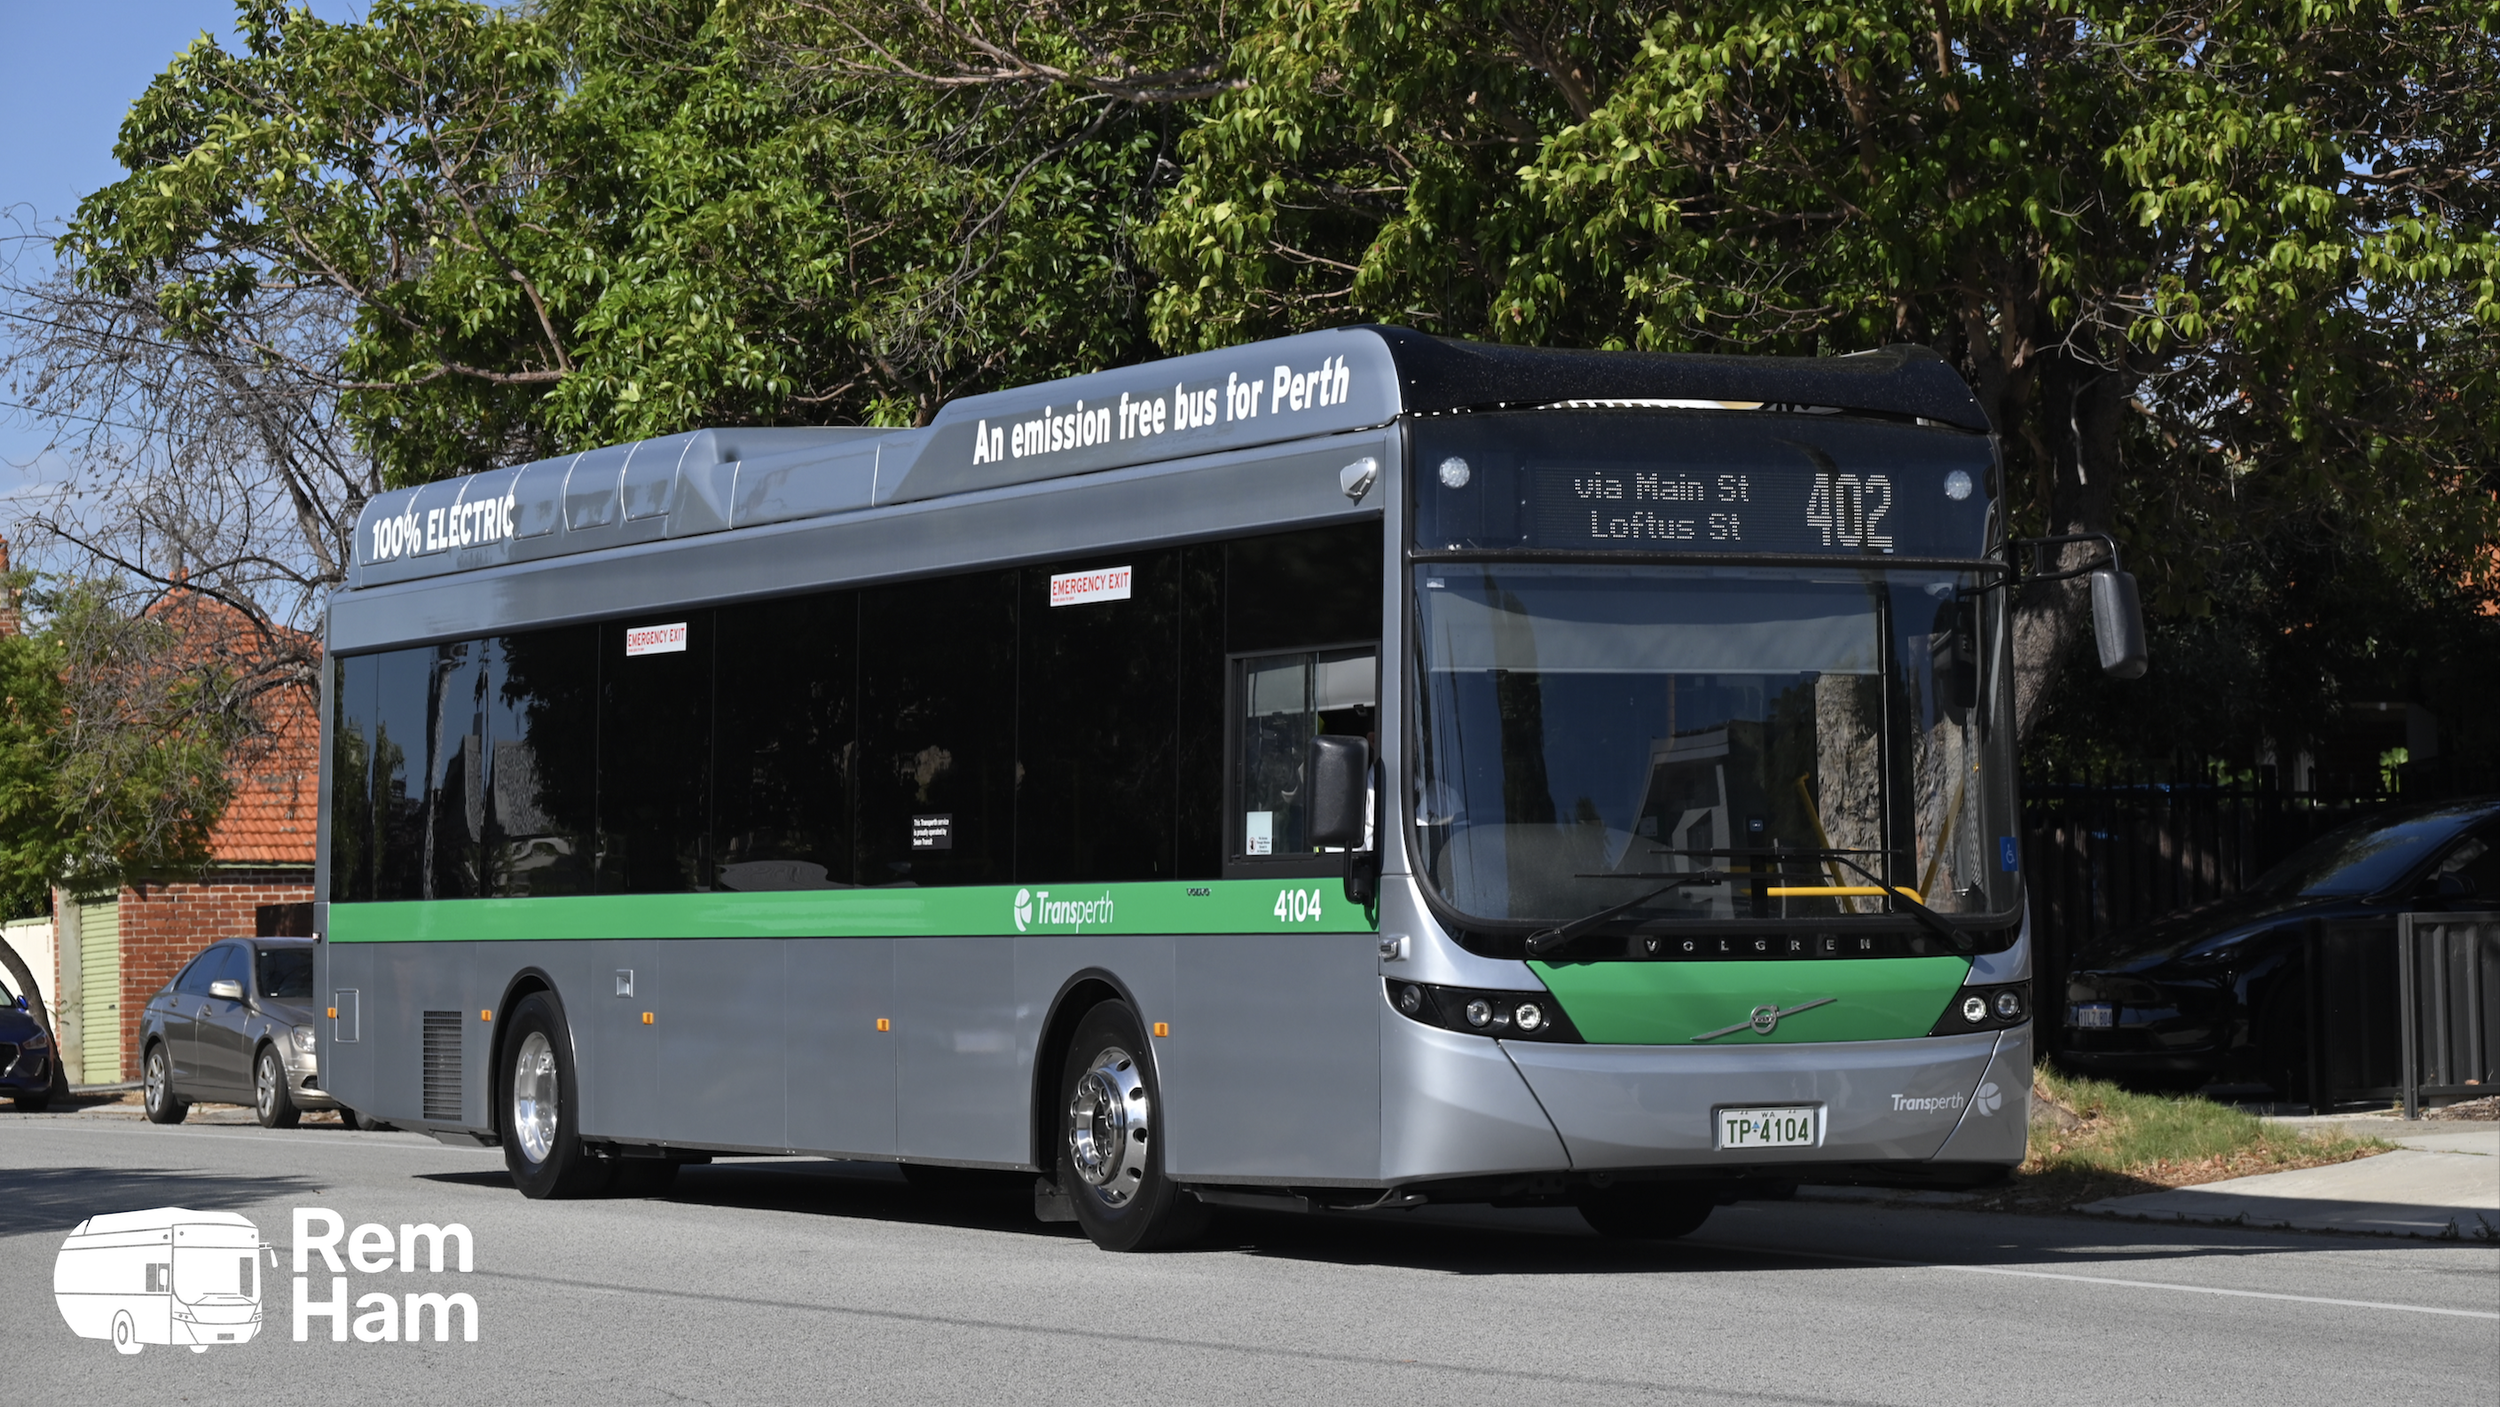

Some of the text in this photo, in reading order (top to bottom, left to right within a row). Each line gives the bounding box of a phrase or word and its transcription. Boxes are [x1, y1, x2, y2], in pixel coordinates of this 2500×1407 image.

[973, 354, 1350, 465] An emission free bus for Perth
[1574, 471, 1749, 502] via Main St
[1591, 510, 1741, 540] Loftus St
[1806, 473, 1893, 547] 402
[372, 494, 515, 560] 100% ELECTRIC
[1053, 572, 1129, 596] EMERGENCY EXIT
[628, 627, 685, 647] EMERGENCY EXIT
[1036, 890, 1114, 934] Transperth
[1274, 888, 1321, 922] 4104
[1646, 938, 1871, 952] VOLGREN
[1891, 1091, 1964, 1115] Transperth
